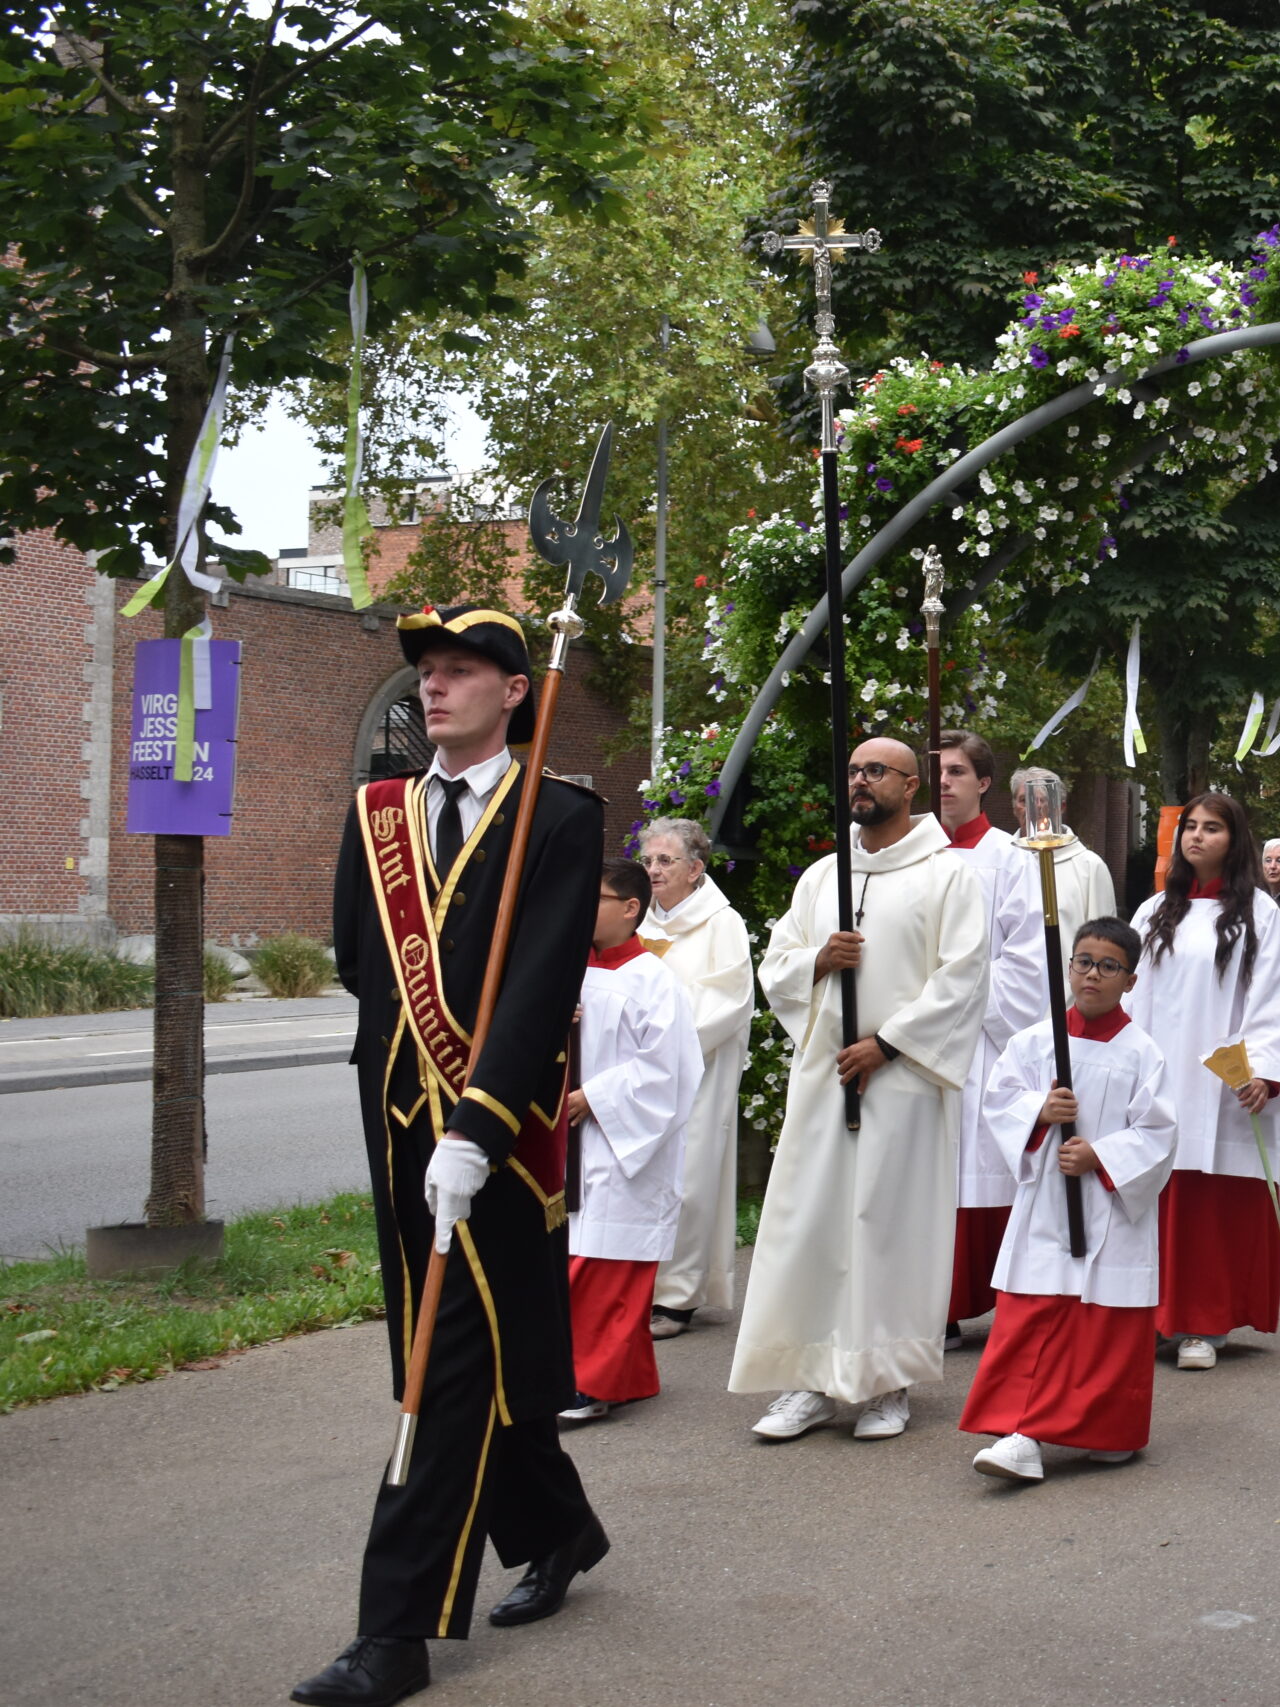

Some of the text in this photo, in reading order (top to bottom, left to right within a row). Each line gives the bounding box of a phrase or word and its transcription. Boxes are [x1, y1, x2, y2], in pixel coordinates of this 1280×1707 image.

[141, 693, 178, 714] VIRG
[140, 717, 178, 738] JESS
[133, 740, 210, 761] FEESTN
[130, 766, 173, 780] HASSELT
[371, 806, 411, 895] Sint
